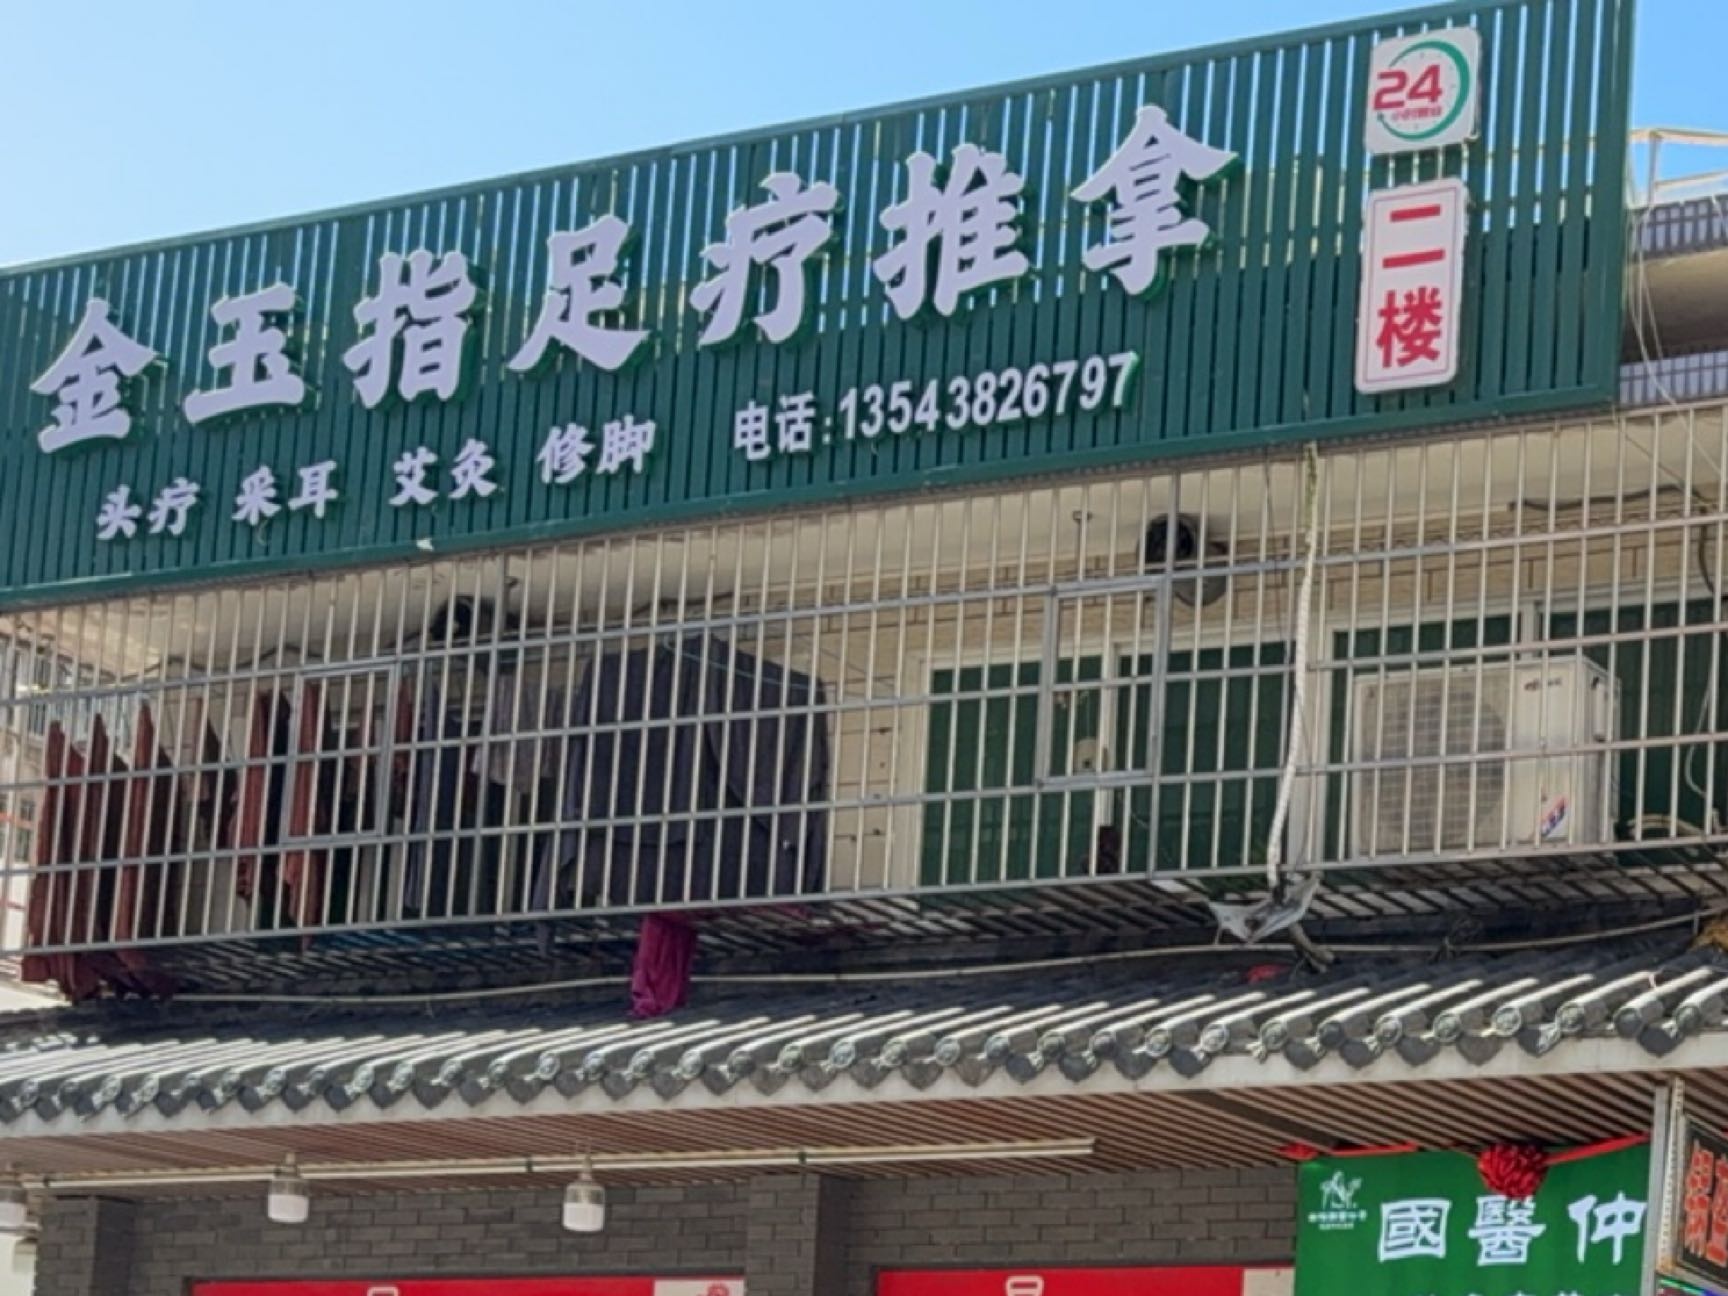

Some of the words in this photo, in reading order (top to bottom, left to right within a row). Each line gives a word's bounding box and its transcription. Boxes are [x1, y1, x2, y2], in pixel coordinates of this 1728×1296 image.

[1374, 64, 1443, 110] 24
[30, 104, 1238, 453] 金玉指足疗推拿
[1376, 203, 1446, 369] 二楼
[732, 350, 1139, 462] 电话:13543826797
[96, 476, 200, 541] 头疗
[232, 460, 339, 526] 采耳
[389, 439, 500, 507] 艾灸
[537, 412, 658, 485] 修脚
